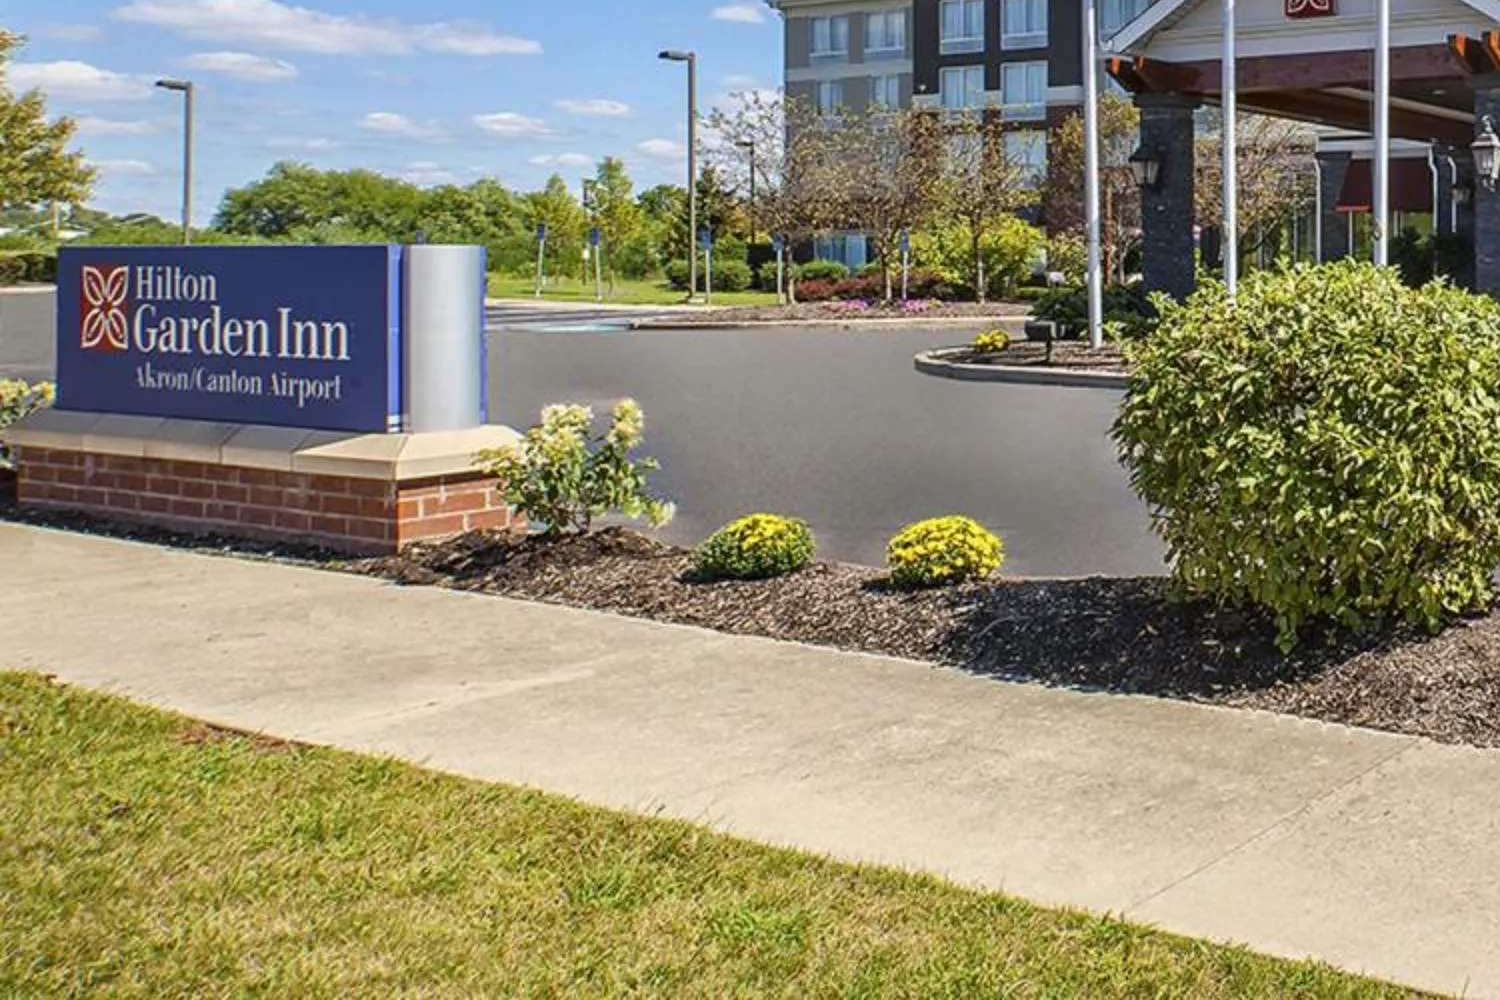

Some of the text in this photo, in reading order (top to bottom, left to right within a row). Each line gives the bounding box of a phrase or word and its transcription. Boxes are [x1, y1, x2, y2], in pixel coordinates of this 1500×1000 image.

[135, 266, 217, 301] Hilton
[134, 304, 350, 361] Garden Inn
[136, 362, 341, 408] Akron/Canton Airport
